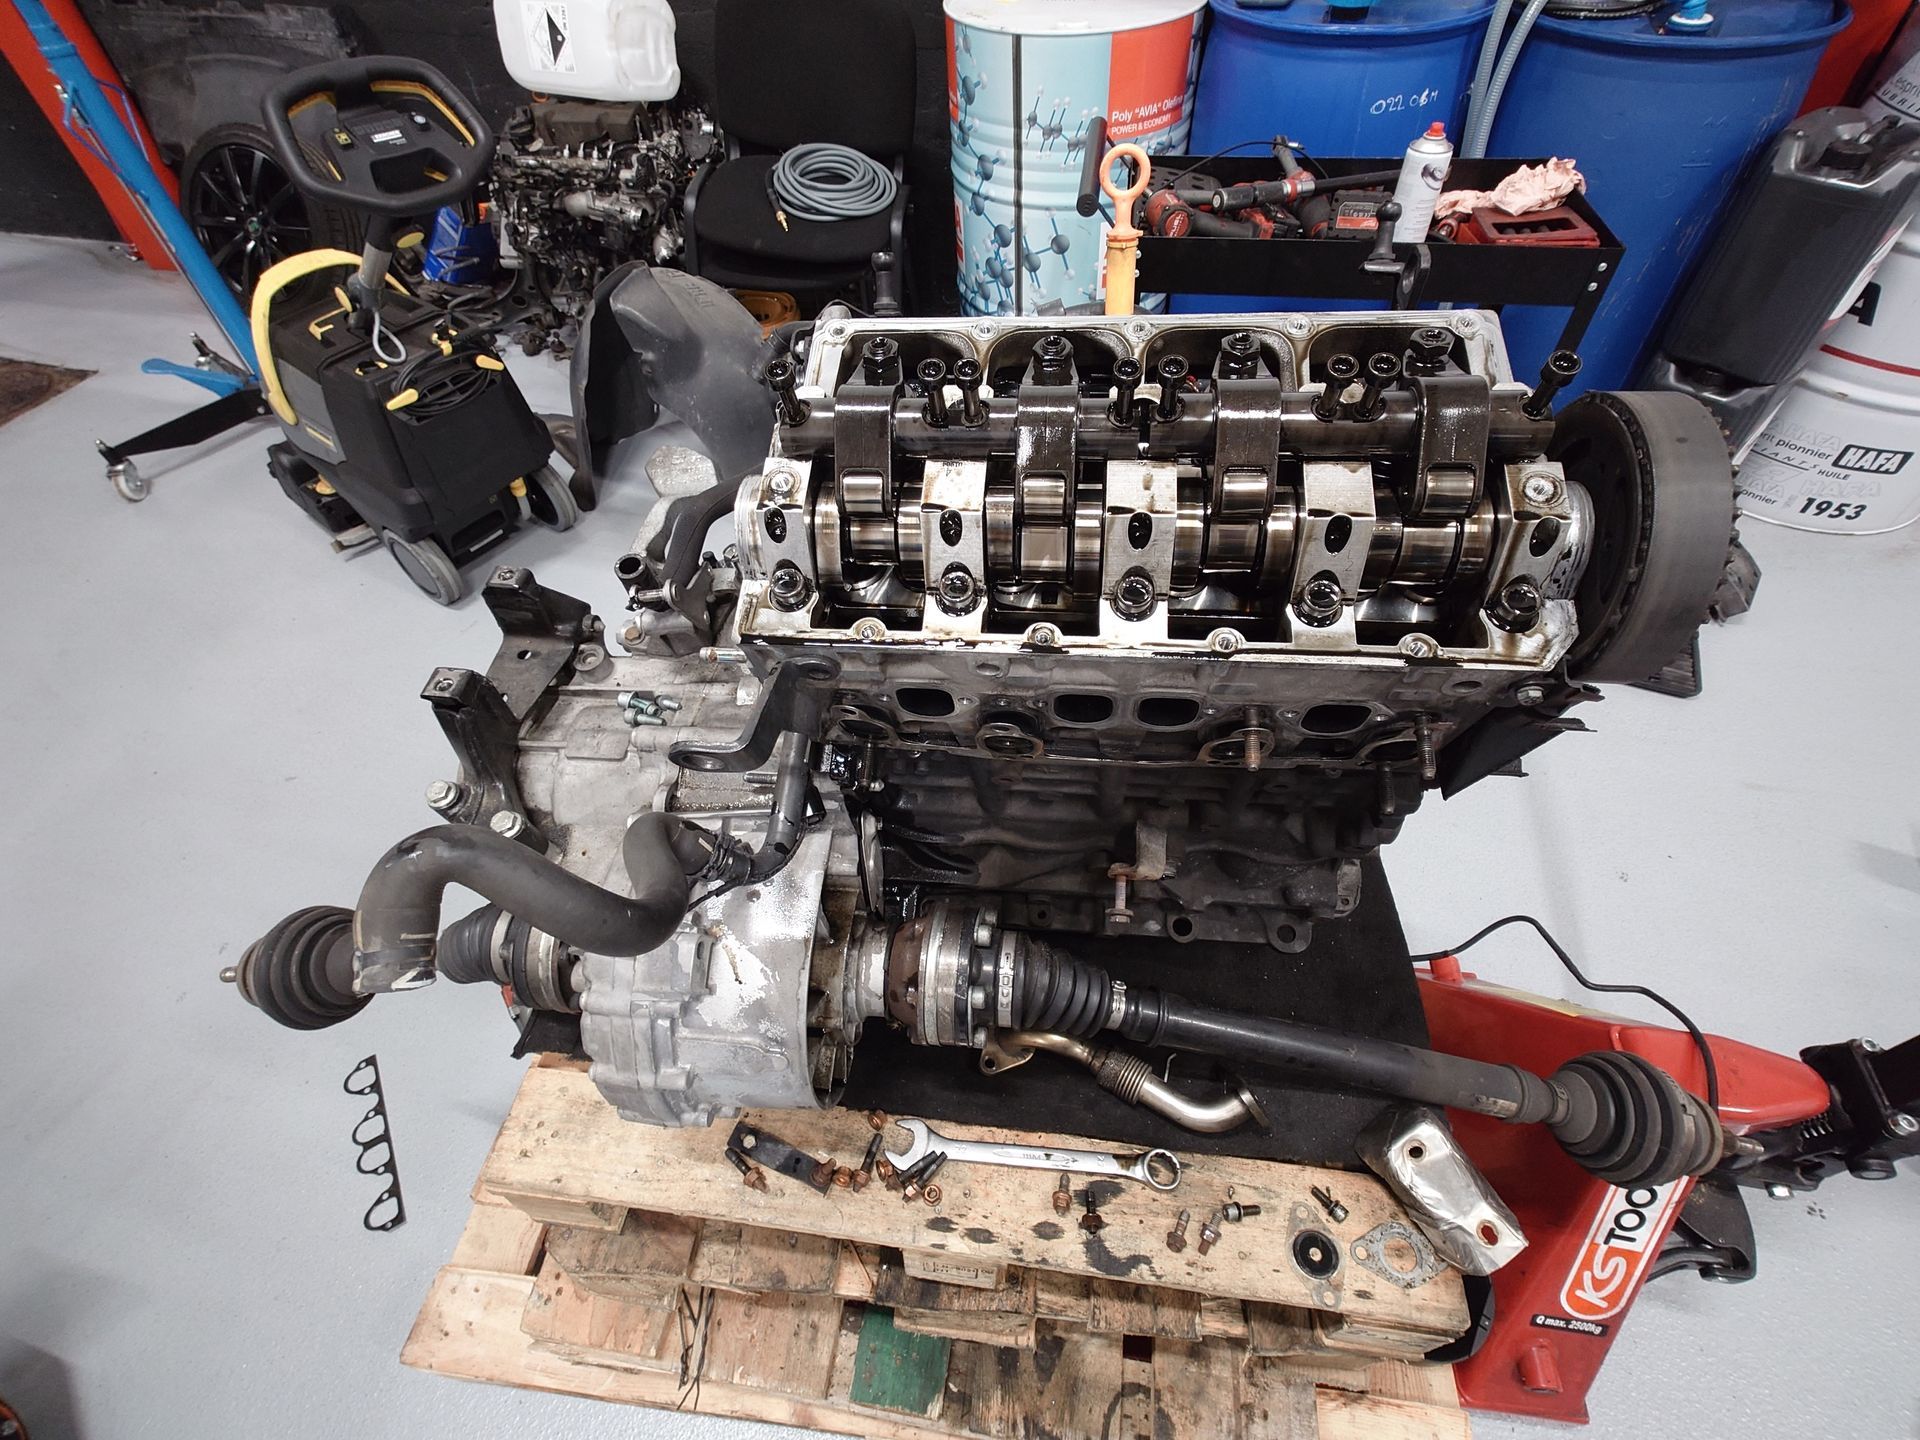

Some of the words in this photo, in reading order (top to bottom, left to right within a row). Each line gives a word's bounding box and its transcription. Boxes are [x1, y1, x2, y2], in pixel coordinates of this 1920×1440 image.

[1111, 122, 1138, 135] POWER
[1138, 121, 1143, 130] &
[1144, 114, 1171, 129] ECONOMY
[1112, 108, 1133, 123] Poly
[1757, 446, 1819, 469] IANTS
[1816, 469, 1852, 481] HUILE
[1775, 439, 1833, 461] pionnier
[1839, 447, 1905, 473] HAFA
[1739, 487, 1778, 505] onnier
[1799, 497, 1868, 520] 1953
[1575, 1245, 1628, 1309] KS
[1603, 1186, 1658, 1245] TOO
[1536, 1315, 1544, 1324] Q
[1544, 1318, 1567, 1328] max.
[1568, 1320, 1603, 1335] 2500kg
